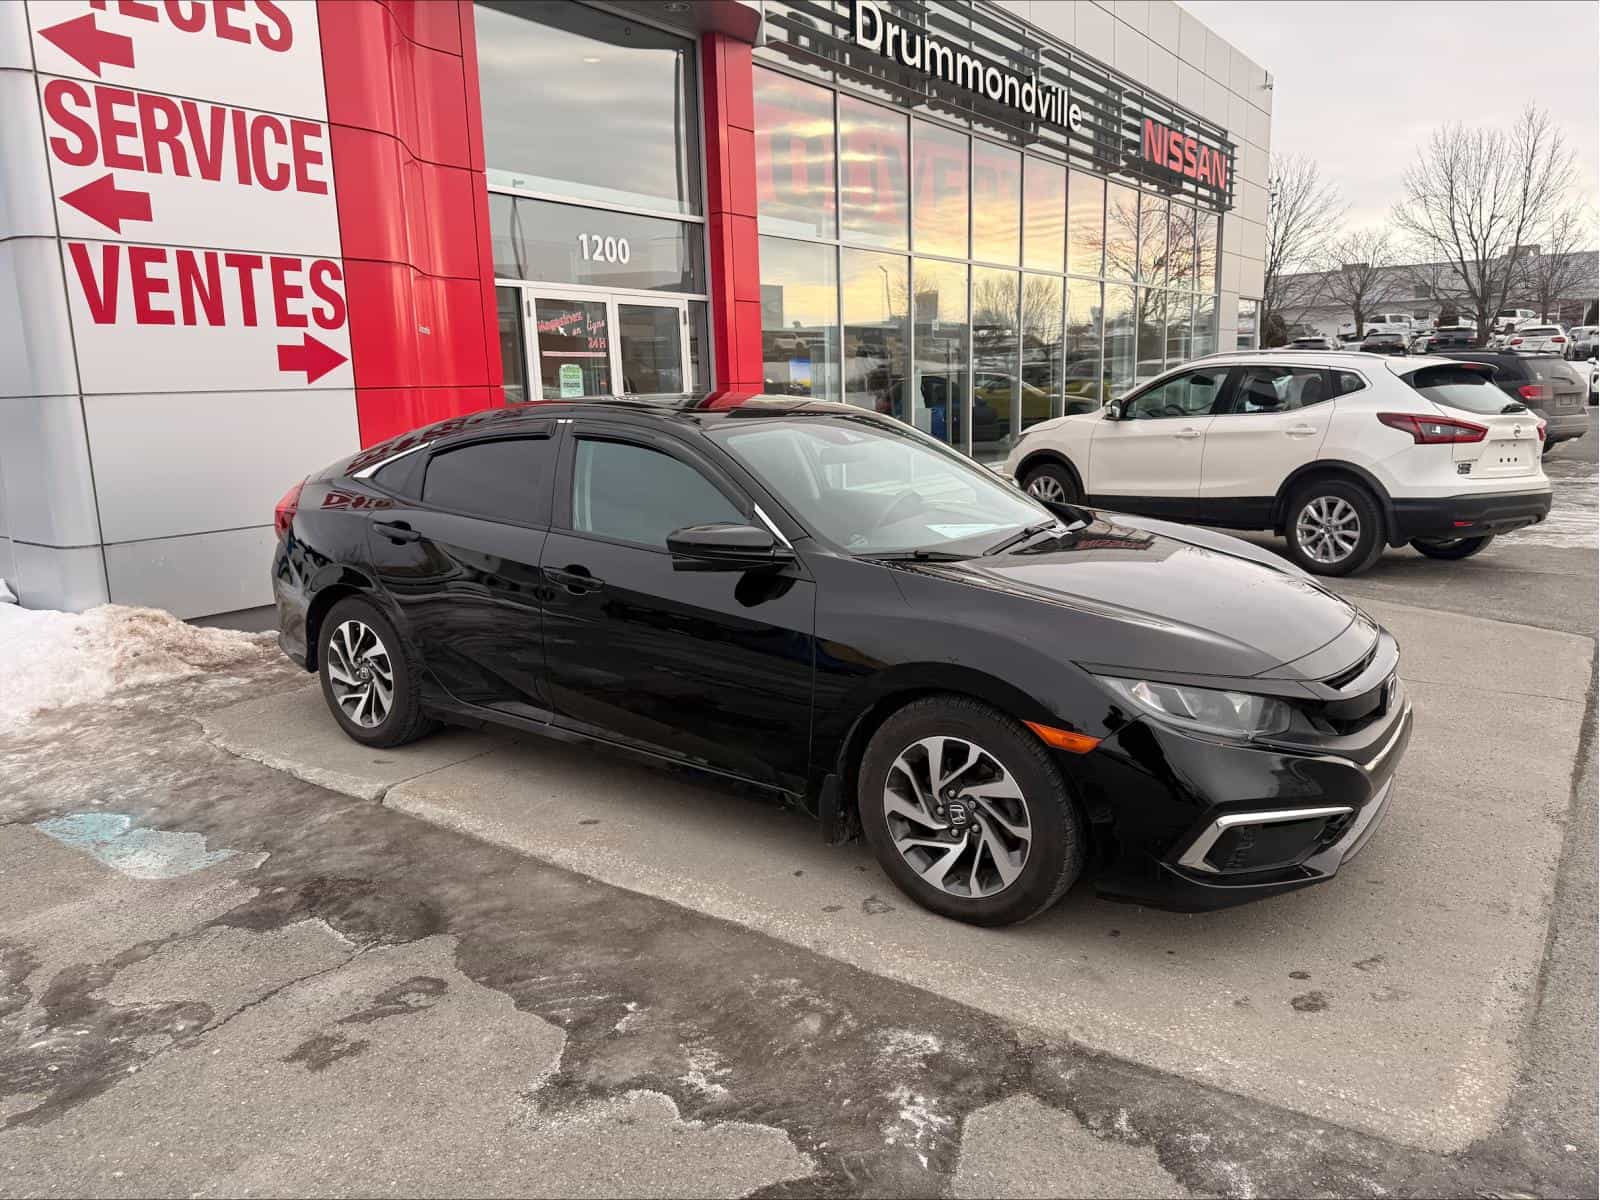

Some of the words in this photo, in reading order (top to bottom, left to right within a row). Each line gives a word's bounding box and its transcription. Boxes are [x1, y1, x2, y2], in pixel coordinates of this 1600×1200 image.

[855, 0, 1083, 132] Drummondville
[44, 79, 328, 195] SERVICE
[1144, 118, 1227, 190] NISSAN
[68, 242, 346, 330] VENTES
[577, 233, 630, 264] 1200
